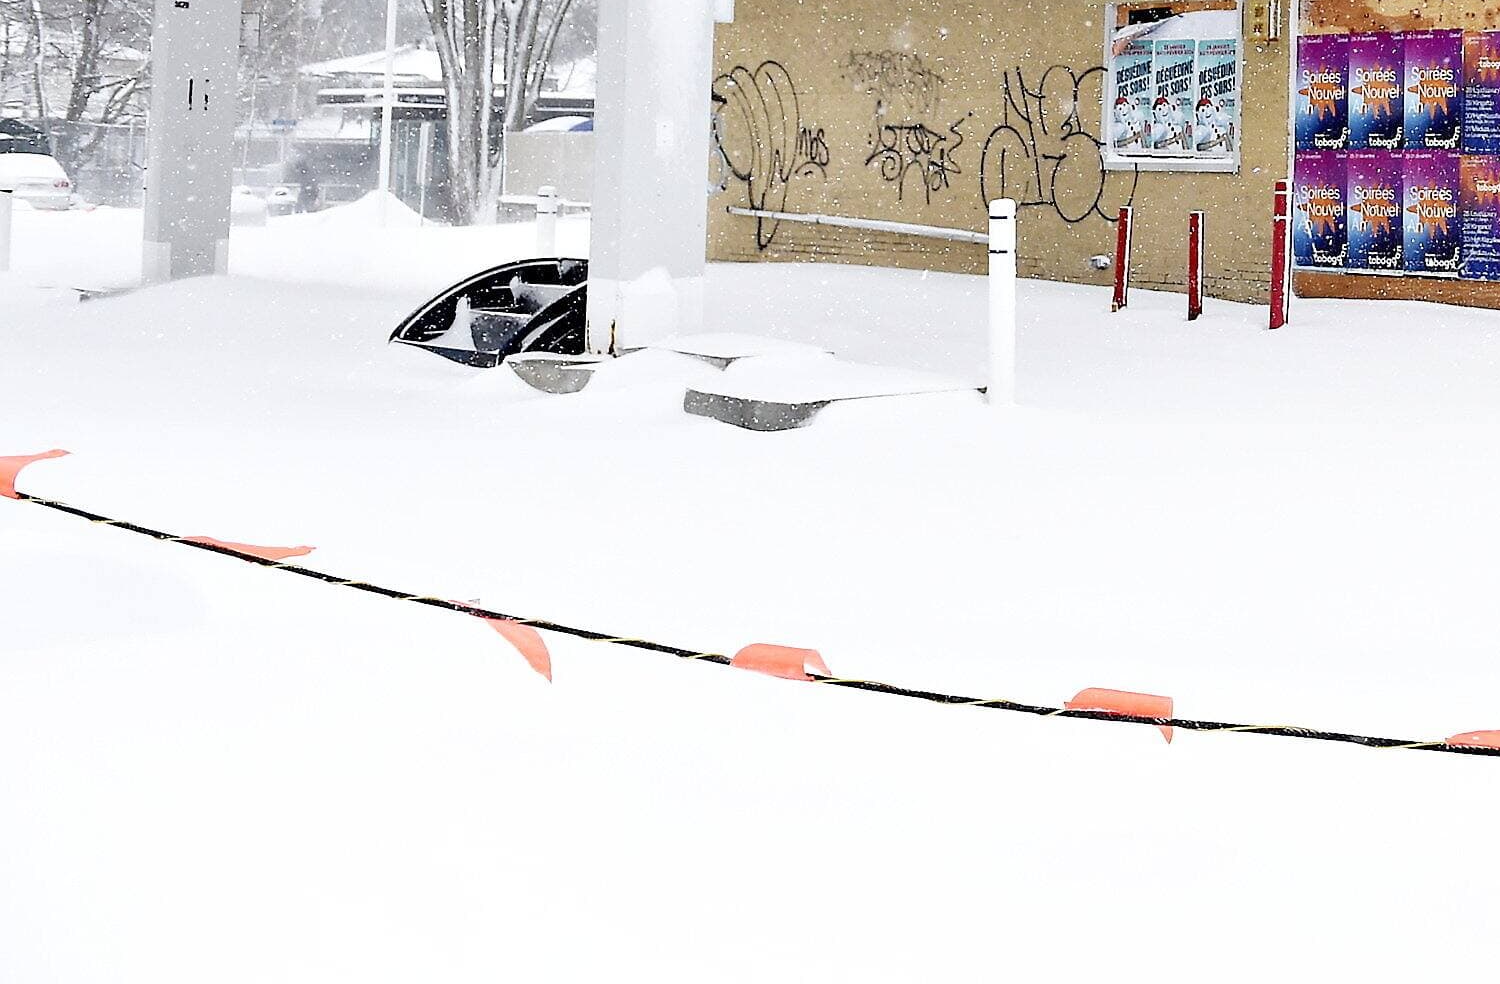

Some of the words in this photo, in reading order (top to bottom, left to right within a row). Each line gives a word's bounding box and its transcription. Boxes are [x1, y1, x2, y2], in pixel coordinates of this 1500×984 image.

[1302, 69, 1342, 84] Soirées
[1355, 67, 1397, 83] Soirées
[1411, 66, 1454, 82] Soirées
[1308, 85, 1345, 100] Nouvel
[1361, 83, 1400, 99] Nouvel
[1417, 82, 1457, 98] Nouvel
[1300, 102, 1314, 115] An
[1352, 101, 1367, 115] An
[1408, 101, 1424, 114] An
[1300, 185, 1341, 200] Soirées
[1354, 185, 1395, 200] Soirées
[1409, 185, 1453, 201] Soirées
[1306, 202, 1344, 217] Nouvel
[1360, 202, 1400, 218] Nouvel
[1416, 202, 1457, 218] Nouvel
[1351, 220, 1367, 233] An
[1407, 219, 1424, 234] An
